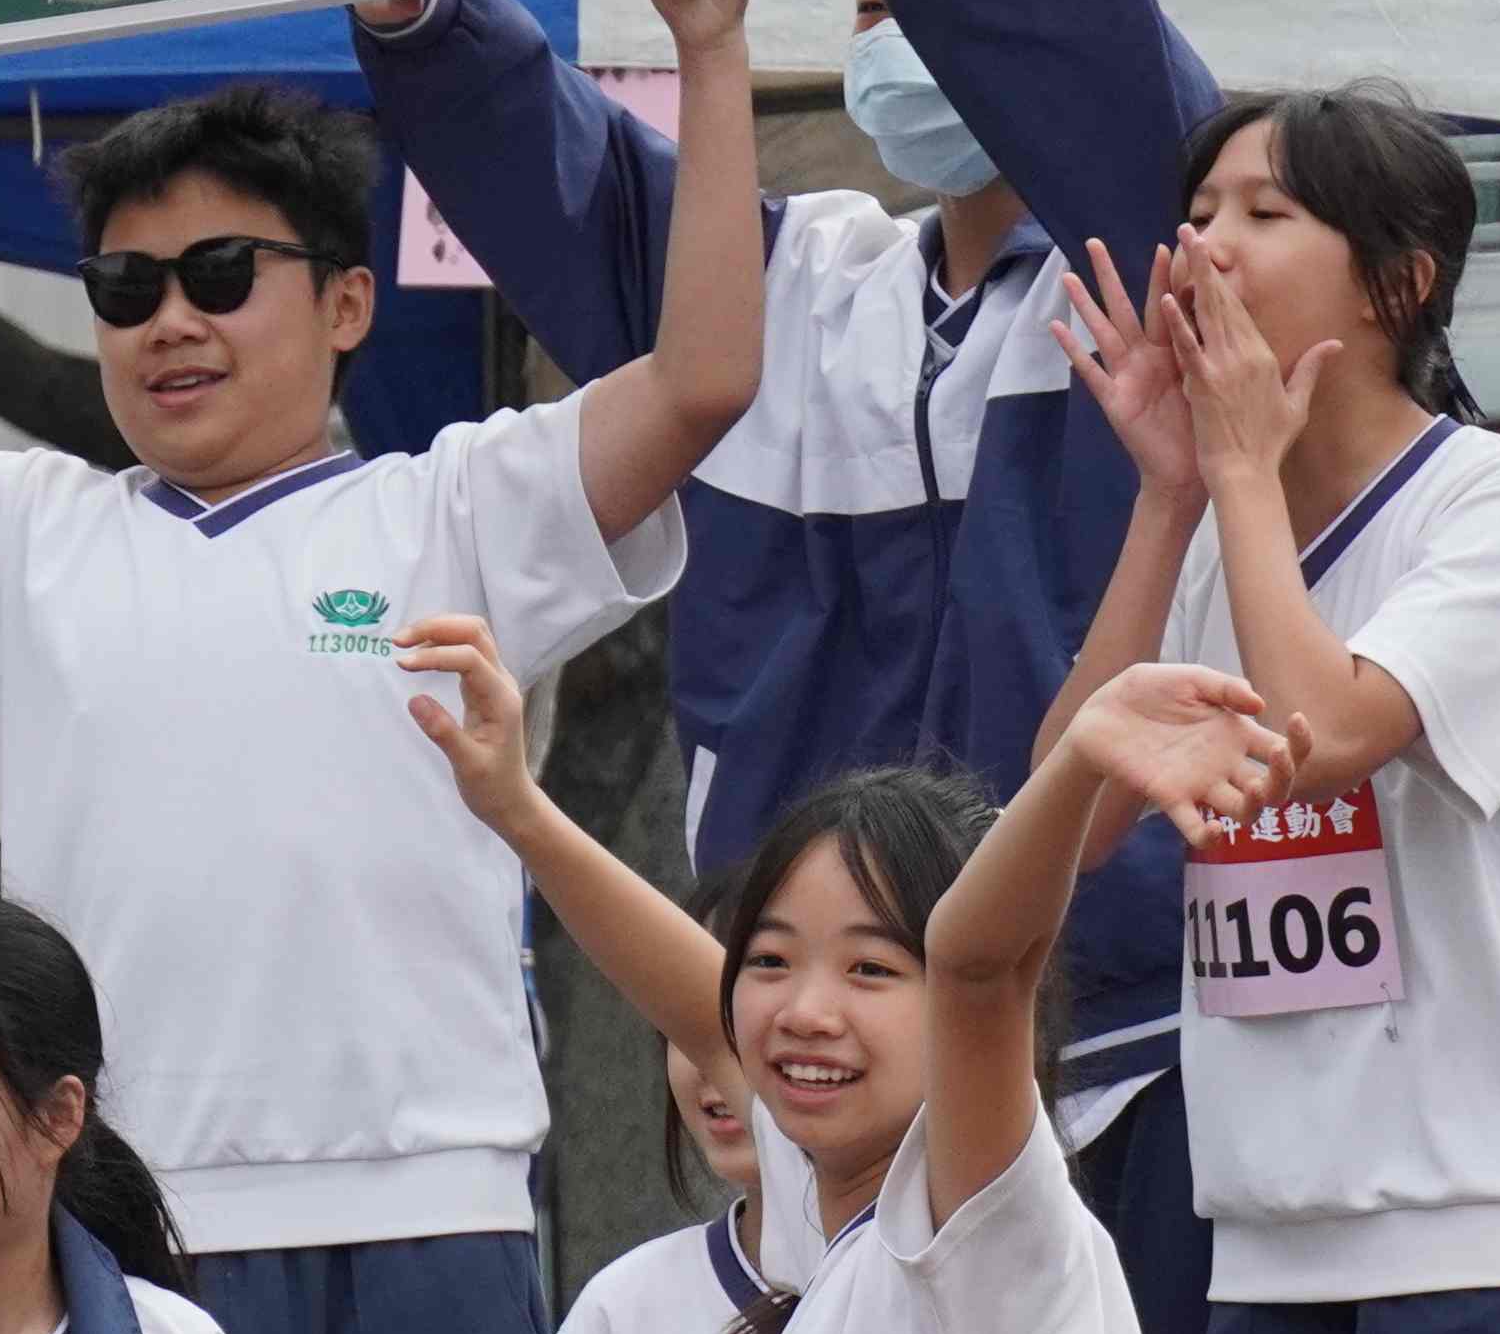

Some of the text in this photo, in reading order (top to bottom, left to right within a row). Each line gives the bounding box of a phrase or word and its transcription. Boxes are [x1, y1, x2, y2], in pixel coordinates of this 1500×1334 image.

[307, 634, 392, 658] 1130016
[1199, 797, 1359, 846] 中運動會
[1187, 886, 1382, 979] 11106
